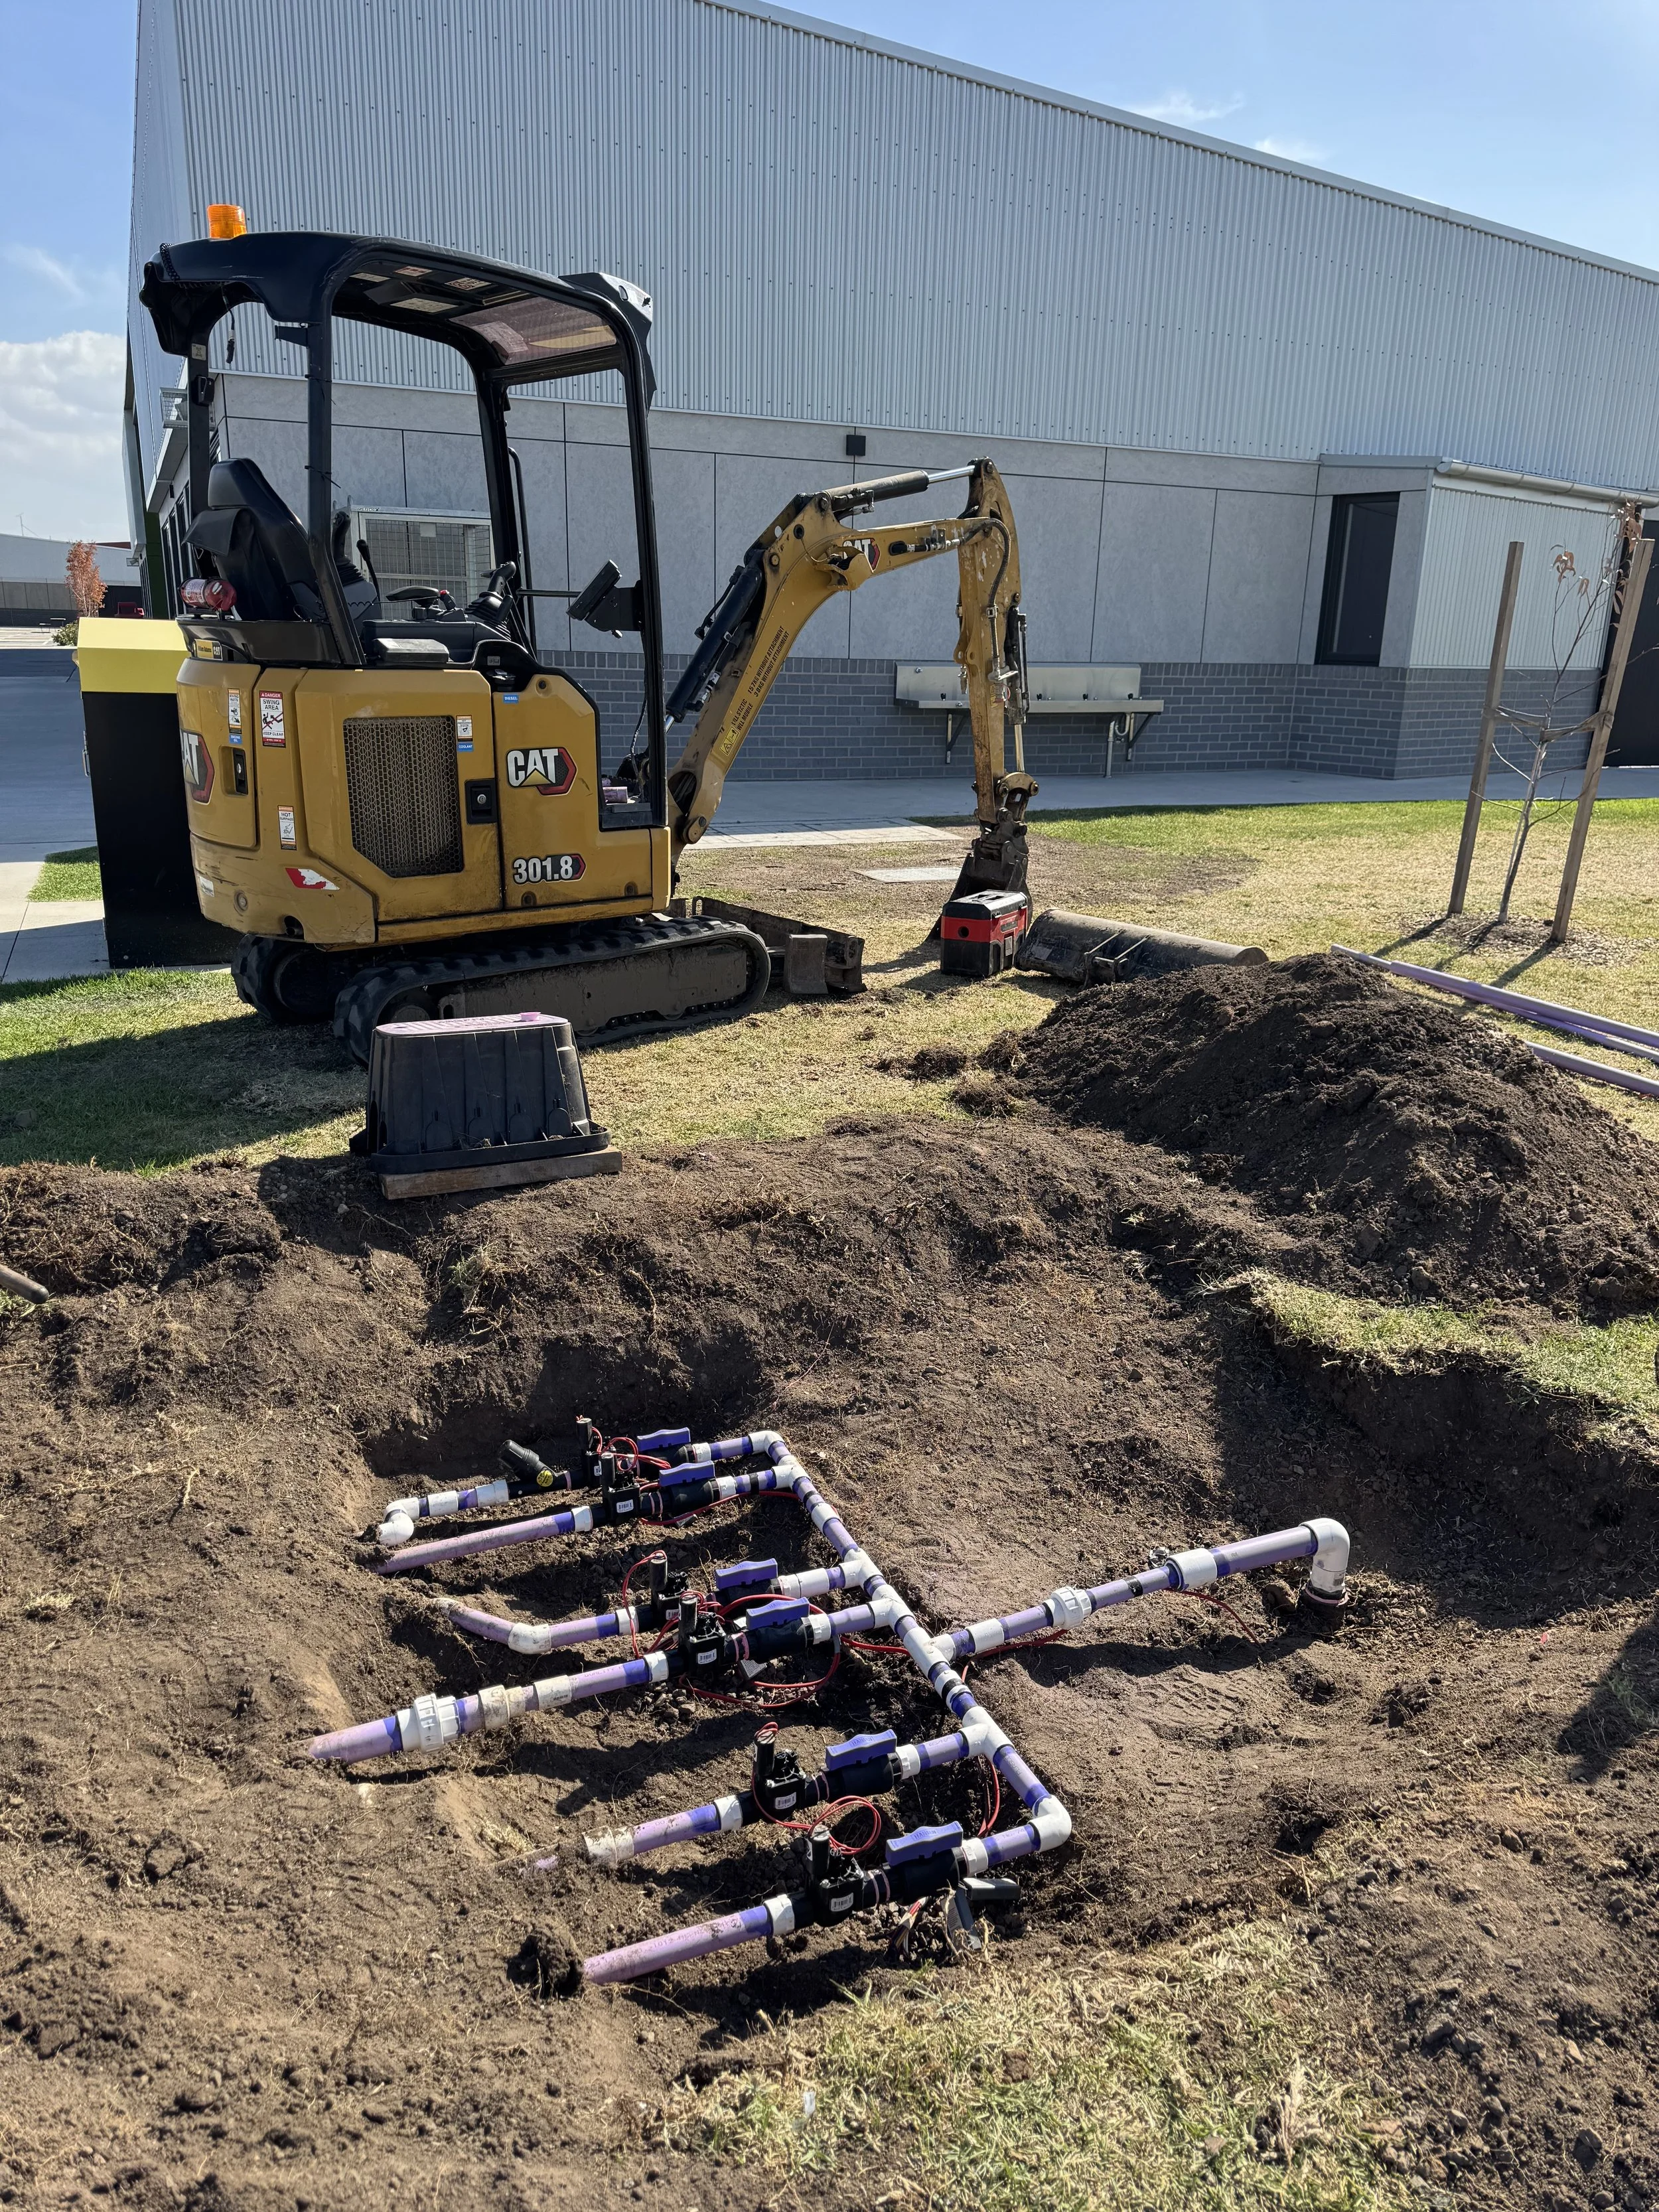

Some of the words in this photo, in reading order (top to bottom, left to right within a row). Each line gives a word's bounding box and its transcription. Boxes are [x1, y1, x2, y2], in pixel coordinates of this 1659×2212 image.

[843, 538, 871, 559] AT
[736, 699, 748, 716] STATIC
[757, 656, 769, 679] WITHOUT
[768, 625, 784, 658] ATTACHMENT
[741, 703, 753, 721] MOBILE
[762, 660, 774, 683] WITHOUT
[773, 630, 790, 662] ATTACHMENT
[179, 729, 199, 785] AT
[507, 748, 559, 786] CAT
[513, 855, 573, 884] 301.8
